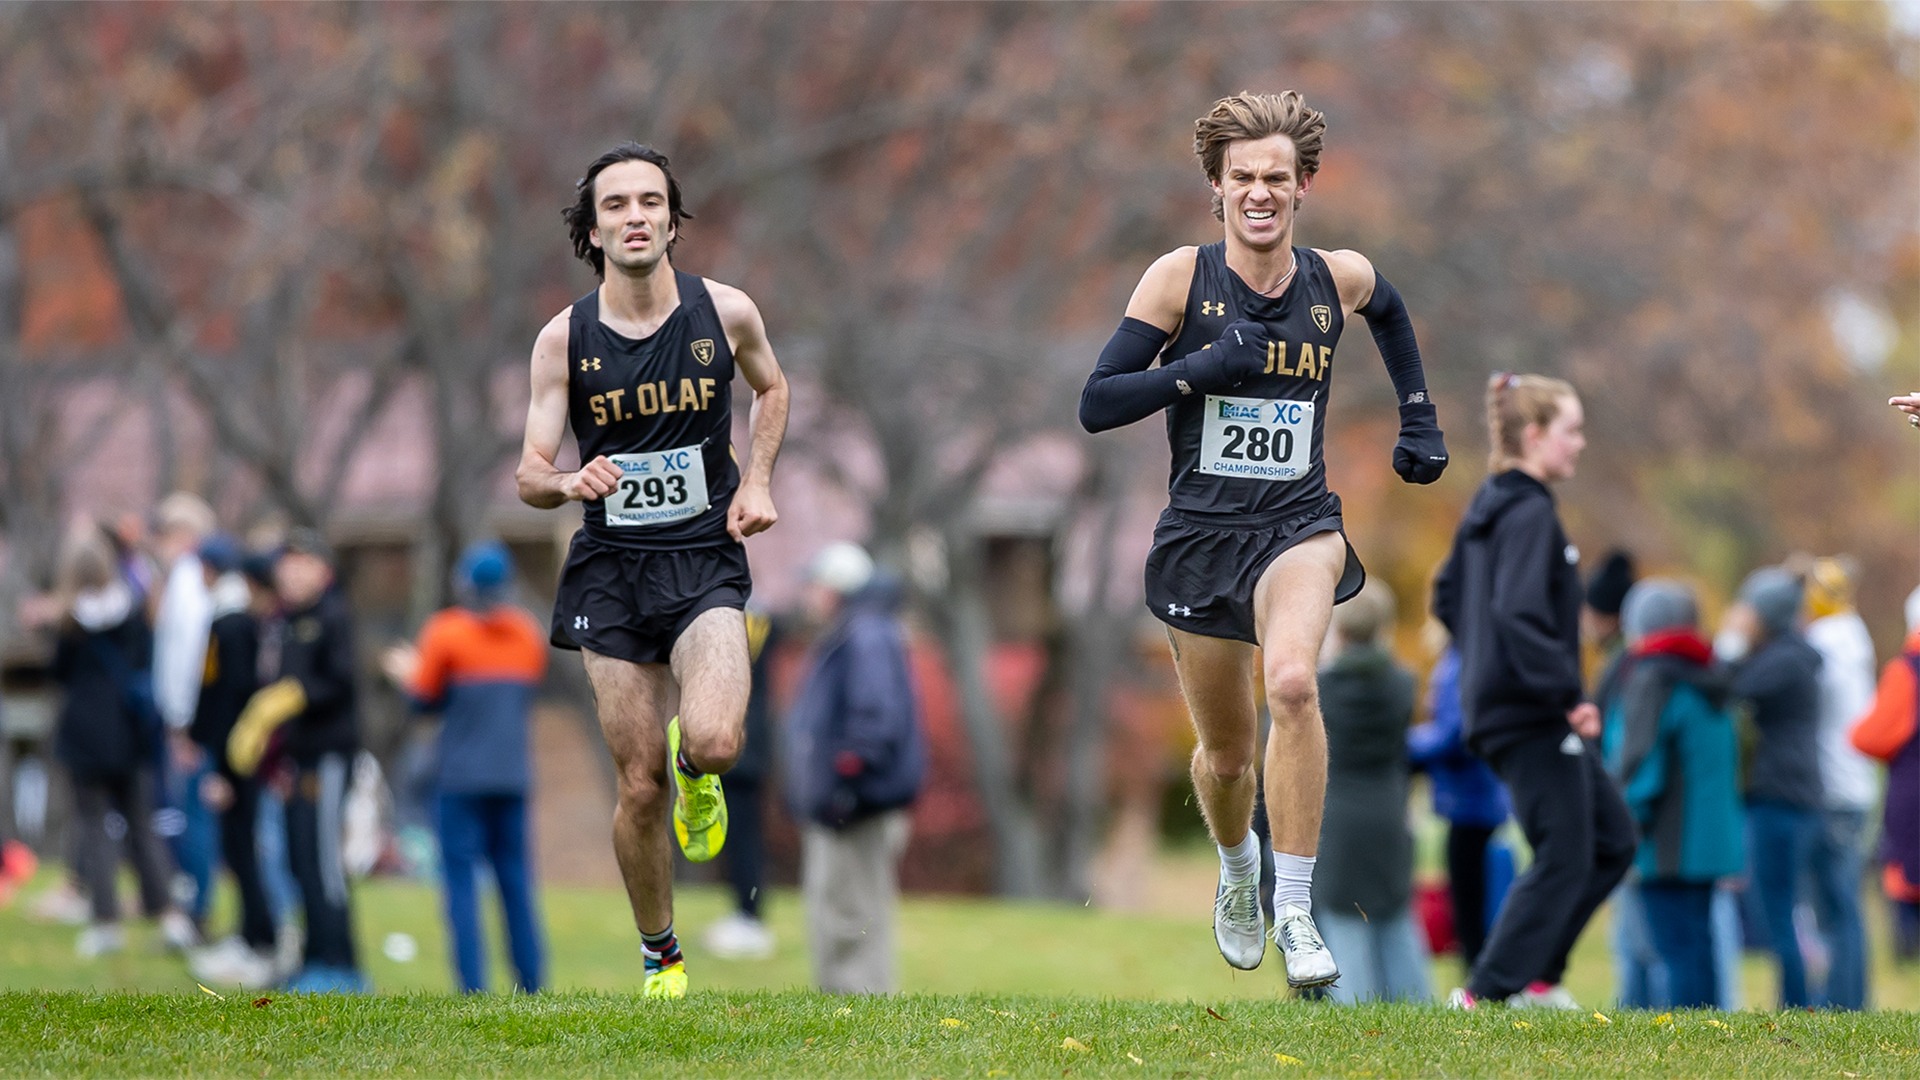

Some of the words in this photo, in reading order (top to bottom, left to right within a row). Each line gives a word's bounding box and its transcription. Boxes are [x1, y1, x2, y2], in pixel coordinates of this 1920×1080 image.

[589, 388, 633, 426] ST.
[637, 378, 716, 416] OLAF
[1224, 404, 1260, 419] MIAC
[1272, 403, 1302, 425] XC
[1221, 425, 1294, 464] 280
[661, 451, 690, 472] XC
[1213, 461, 1296, 477] CHAMPIONSHIPS
[621, 474, 689, 509] 293
[619, 506, 697, 521] CHAMPIONSHIPS
